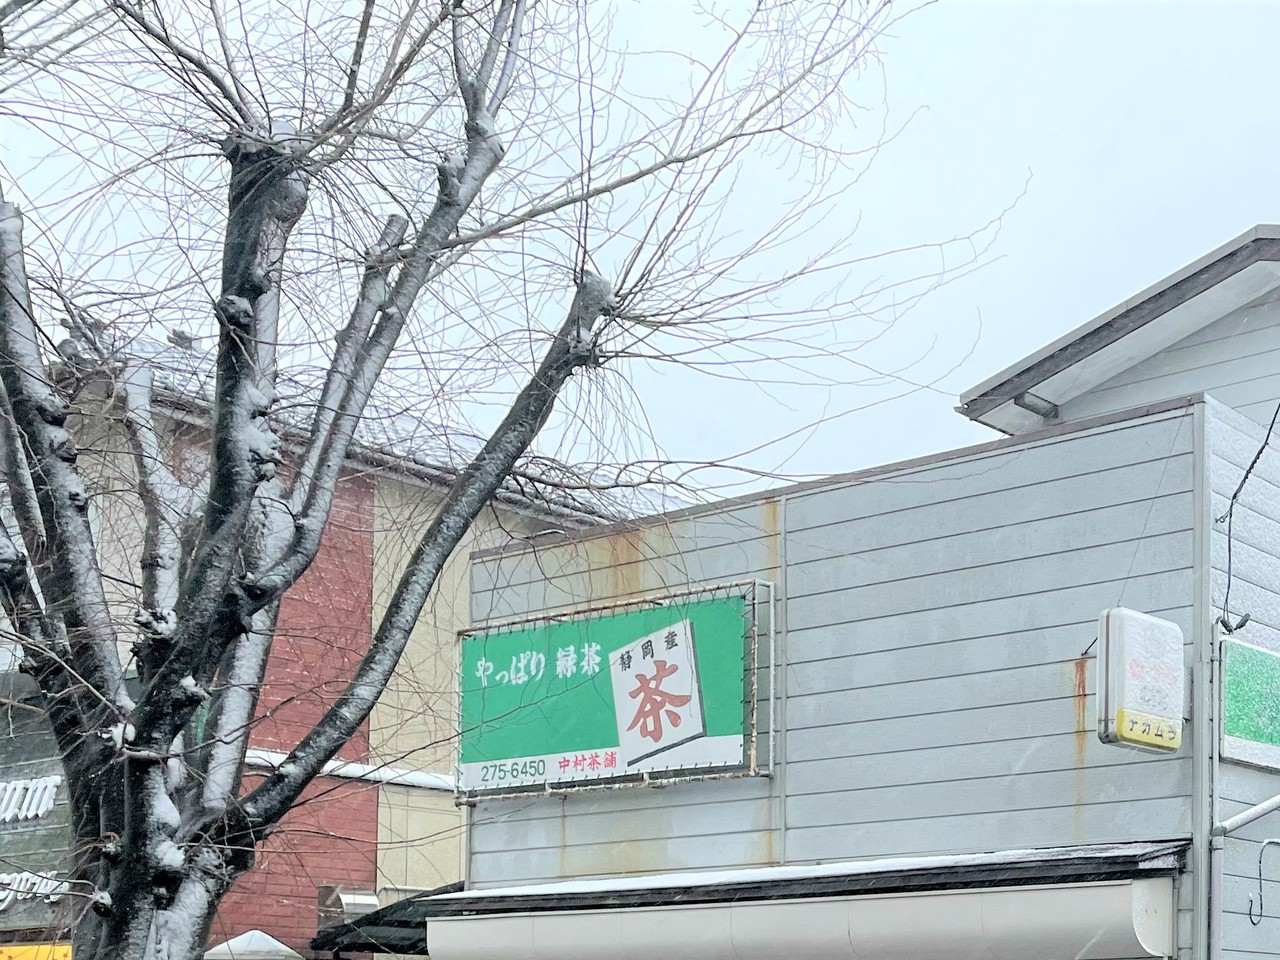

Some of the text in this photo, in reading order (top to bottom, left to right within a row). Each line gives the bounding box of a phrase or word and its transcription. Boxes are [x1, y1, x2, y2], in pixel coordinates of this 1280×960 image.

[475, 642, 601, 687] やっぱり 緑茶
[619, 631, 678, 671] 静岡産
[626, 660, 692, 742] 茶
[481, 760, 546, 781] 275-6450
